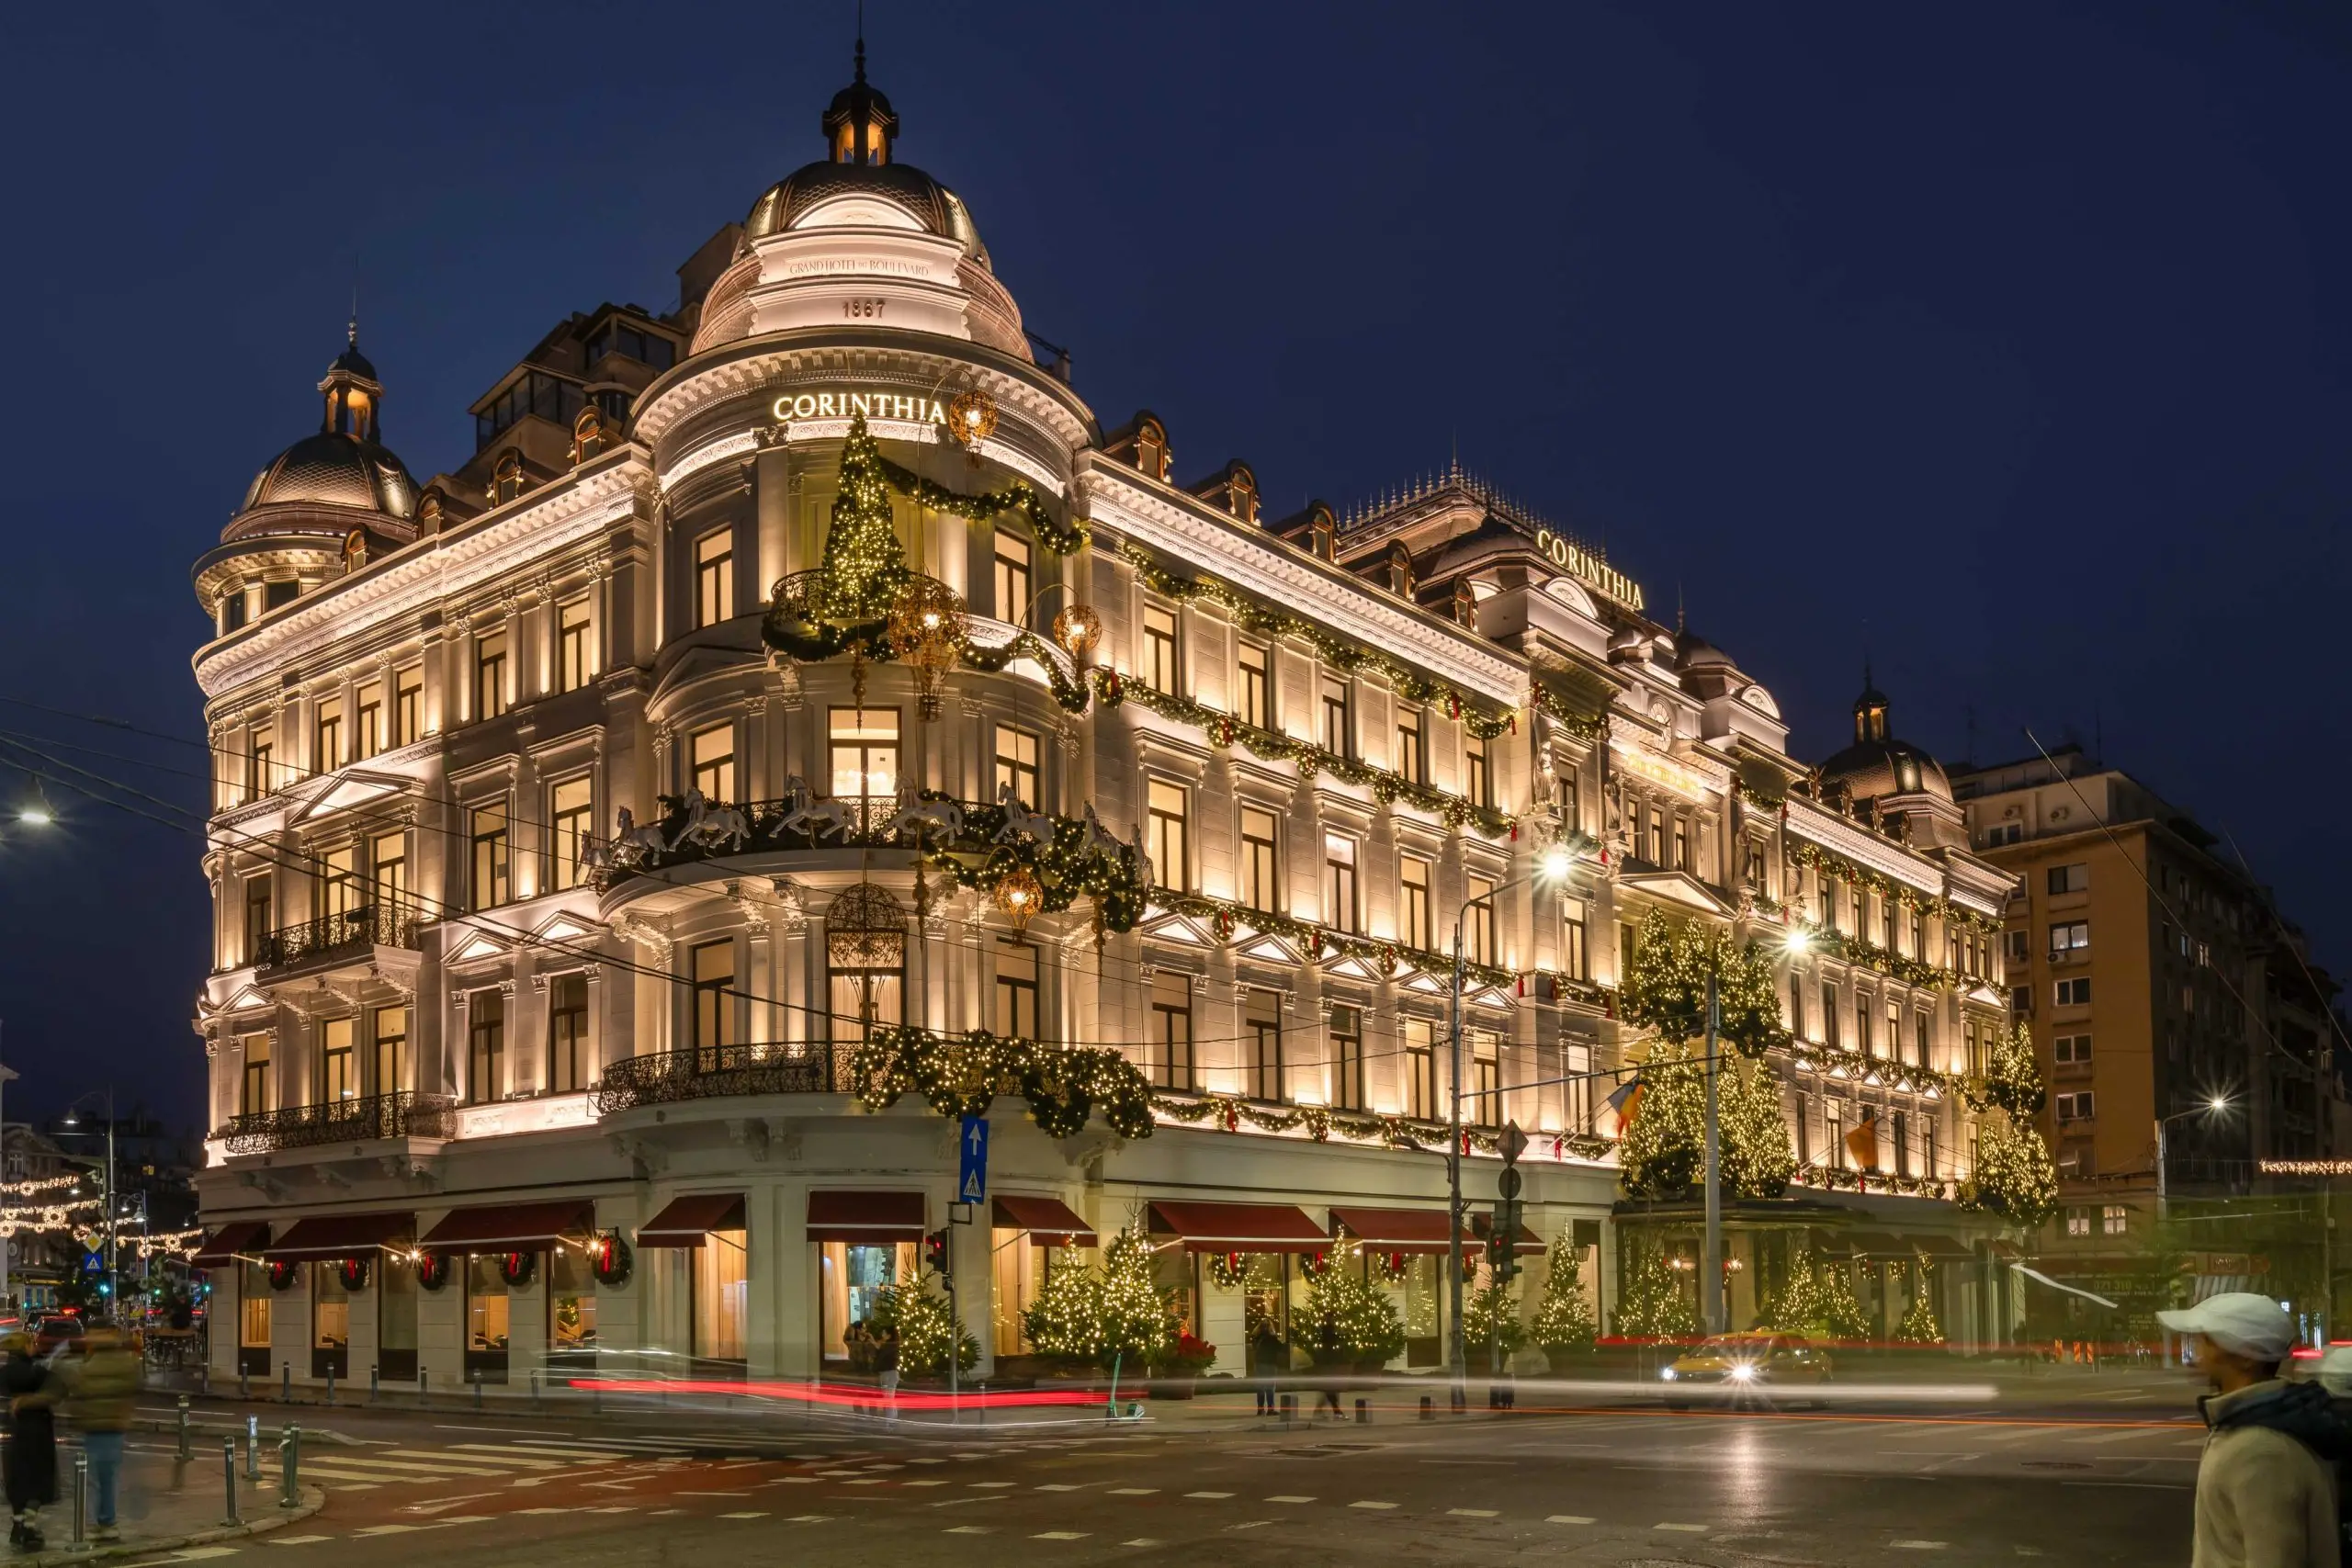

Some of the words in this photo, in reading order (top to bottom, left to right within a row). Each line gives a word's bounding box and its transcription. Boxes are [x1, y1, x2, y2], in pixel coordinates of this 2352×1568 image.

[789, 261, 824, 275] GRAND
[825, 259, 855, 271] HOTEL
[869, 259, 929, 276] BOULEVARD
[842, 299, 886, 320] 1867
[774, 393, 947, 424] CORINTHIA
[1537, 530, 1644, 610] CORINTHIA
